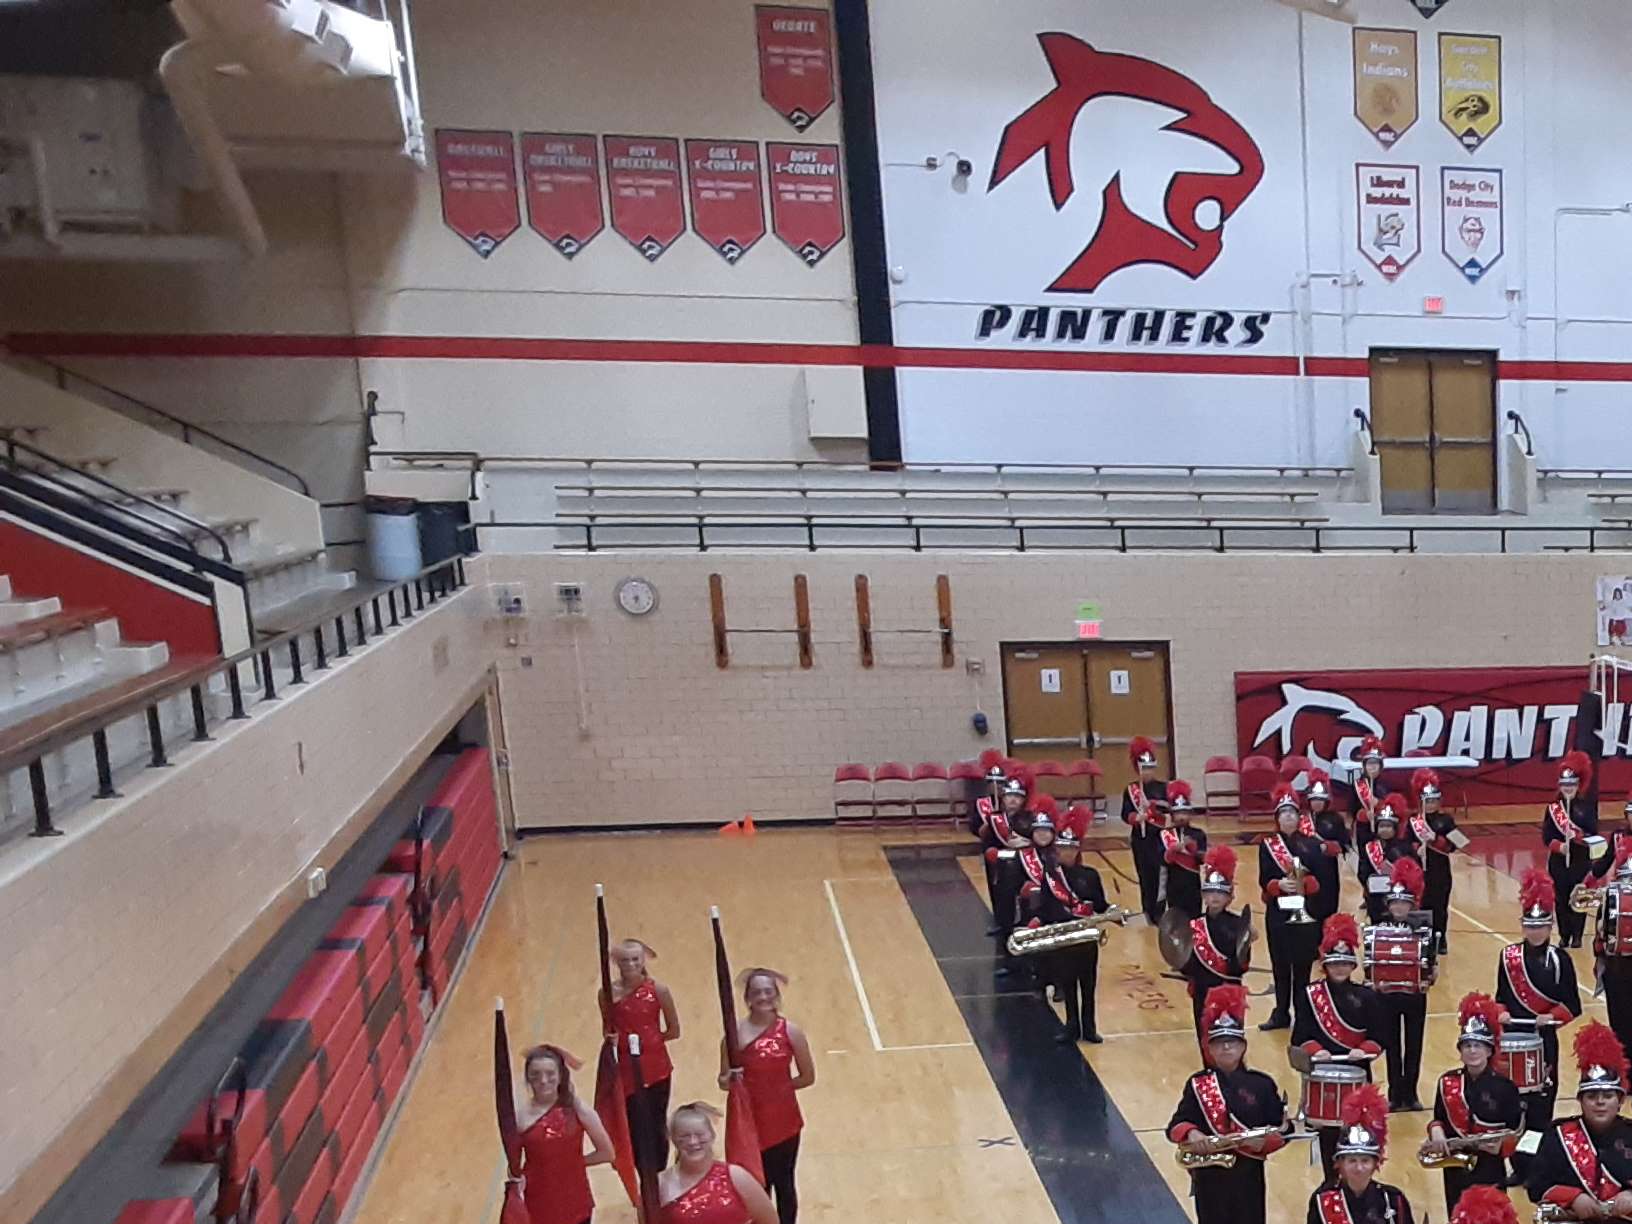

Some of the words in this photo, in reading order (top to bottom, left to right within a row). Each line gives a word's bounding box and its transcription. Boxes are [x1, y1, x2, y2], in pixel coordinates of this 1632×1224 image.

[1362, 63, 1409, 77] Indians
[1449, 179, 1476, 193] Dodge
[1478, 180, 1494, 193] City
[1447, 196, 1463, 207] Red
[1465, 197, 1498, 209] Demons
[974, 305, 1271, 347] PANTHERS
